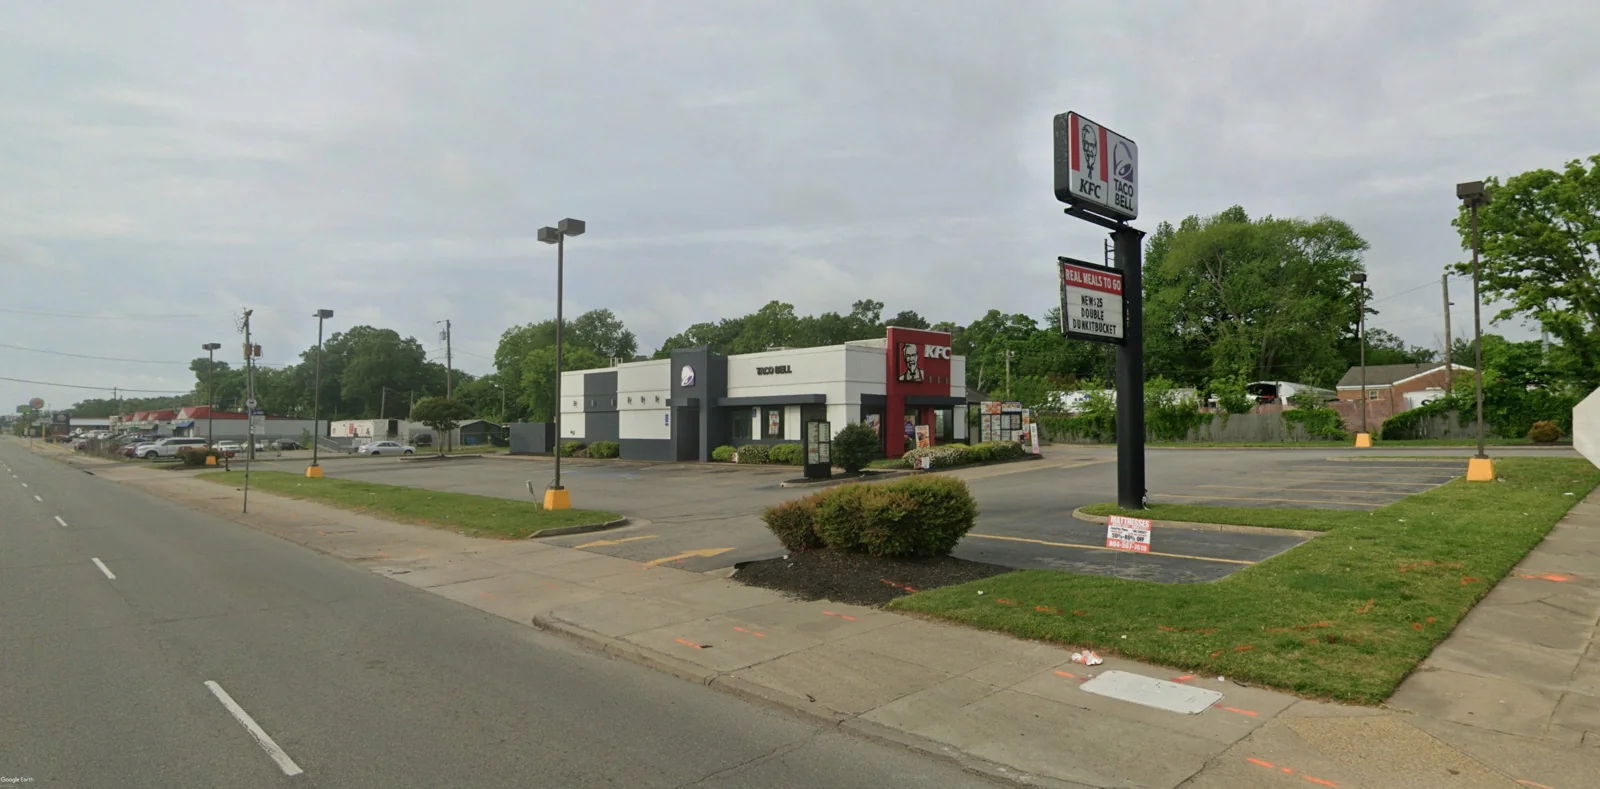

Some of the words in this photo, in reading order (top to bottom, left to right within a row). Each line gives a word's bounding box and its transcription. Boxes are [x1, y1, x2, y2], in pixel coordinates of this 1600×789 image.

[1079, 179, 1101, 199] KFC
[1113, 179, 1134, 197] TACO
[1115, 193, 1133, 211] BELL
[1065, 269, 1082, 283] REAL
[1083, 272, 1102, 287] MEALS
[1104, 277, 1111, 289] TO
[1113, 279, 1121, 291] GO
[1081, 308, 1104, 321] DOUBLE
[924, 344, 951, 360] KFC
[756, 366, 774, 376] TACO
[775, 365, 792, 374] BELL
